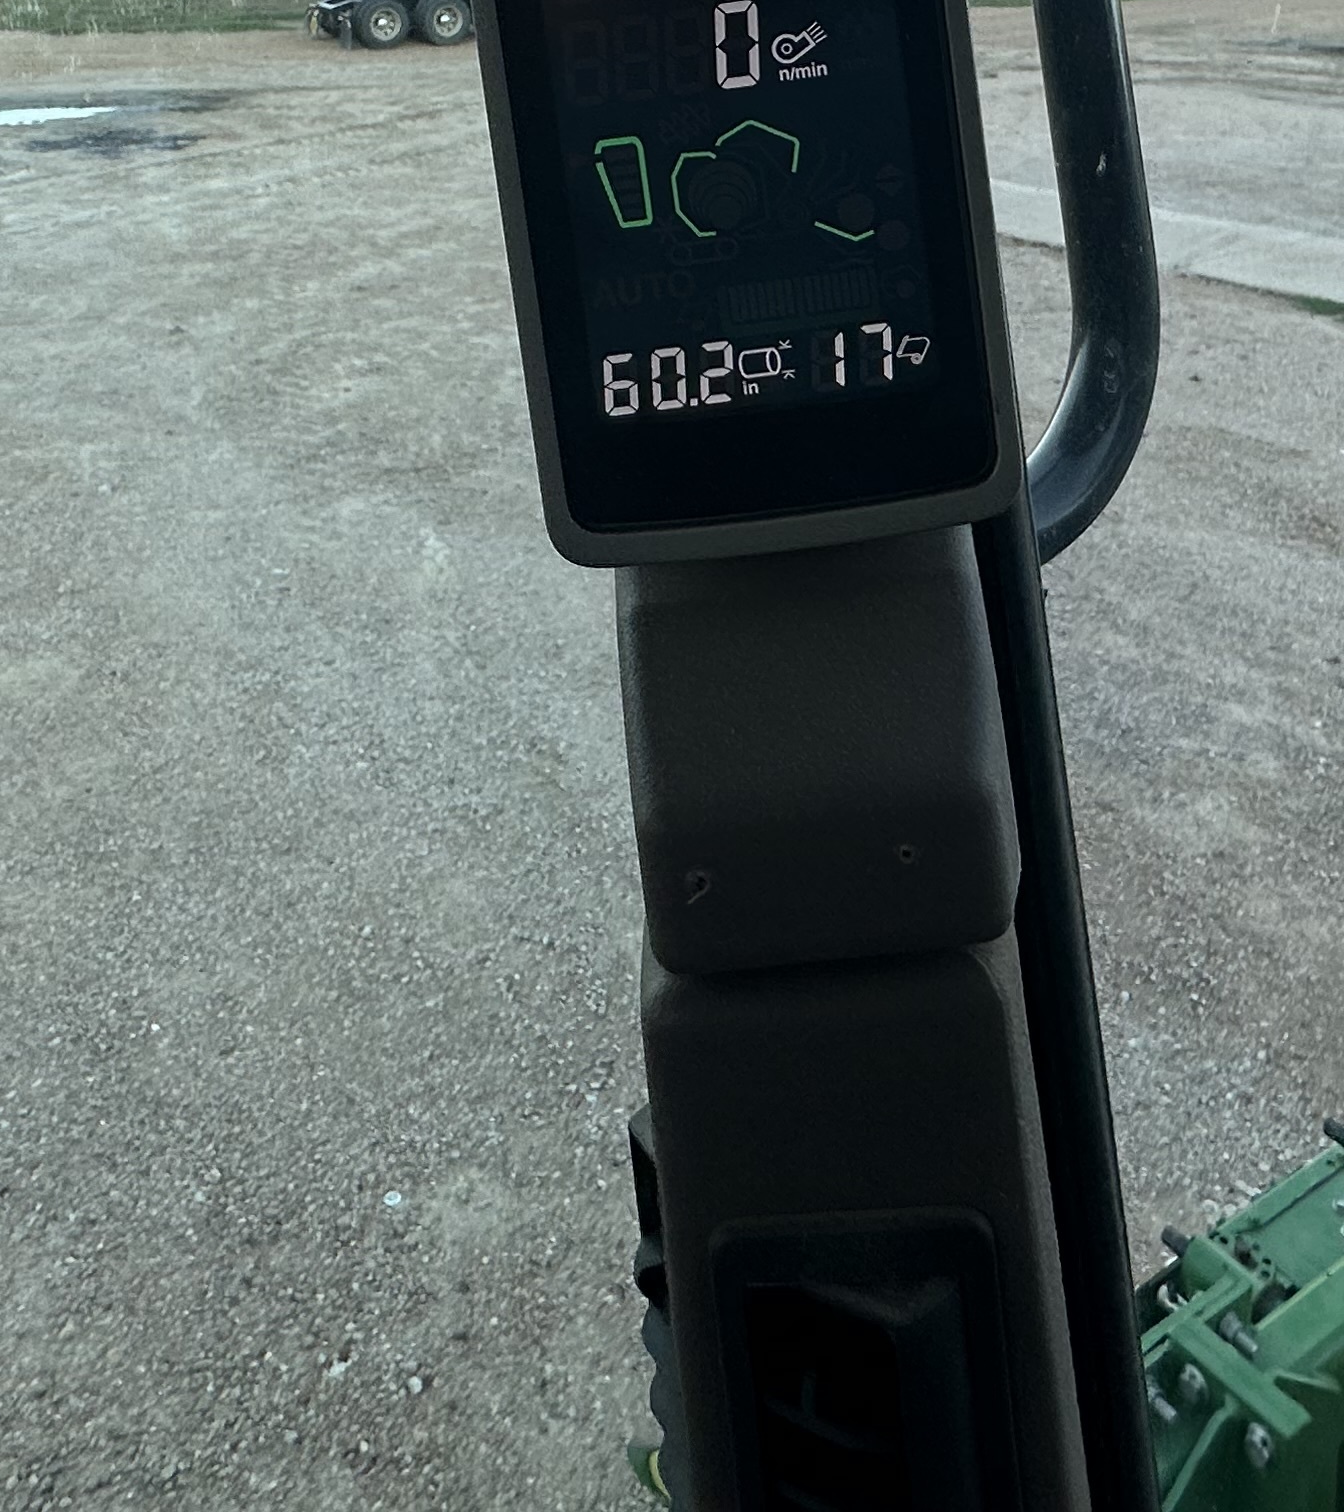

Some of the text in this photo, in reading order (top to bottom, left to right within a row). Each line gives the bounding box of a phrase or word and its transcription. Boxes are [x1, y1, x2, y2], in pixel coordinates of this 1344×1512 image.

[714, 0, 829, 90] 0 n/min
[602, 340, 759, 418] 60.2 in
[833, 322, 894, 388] 17
